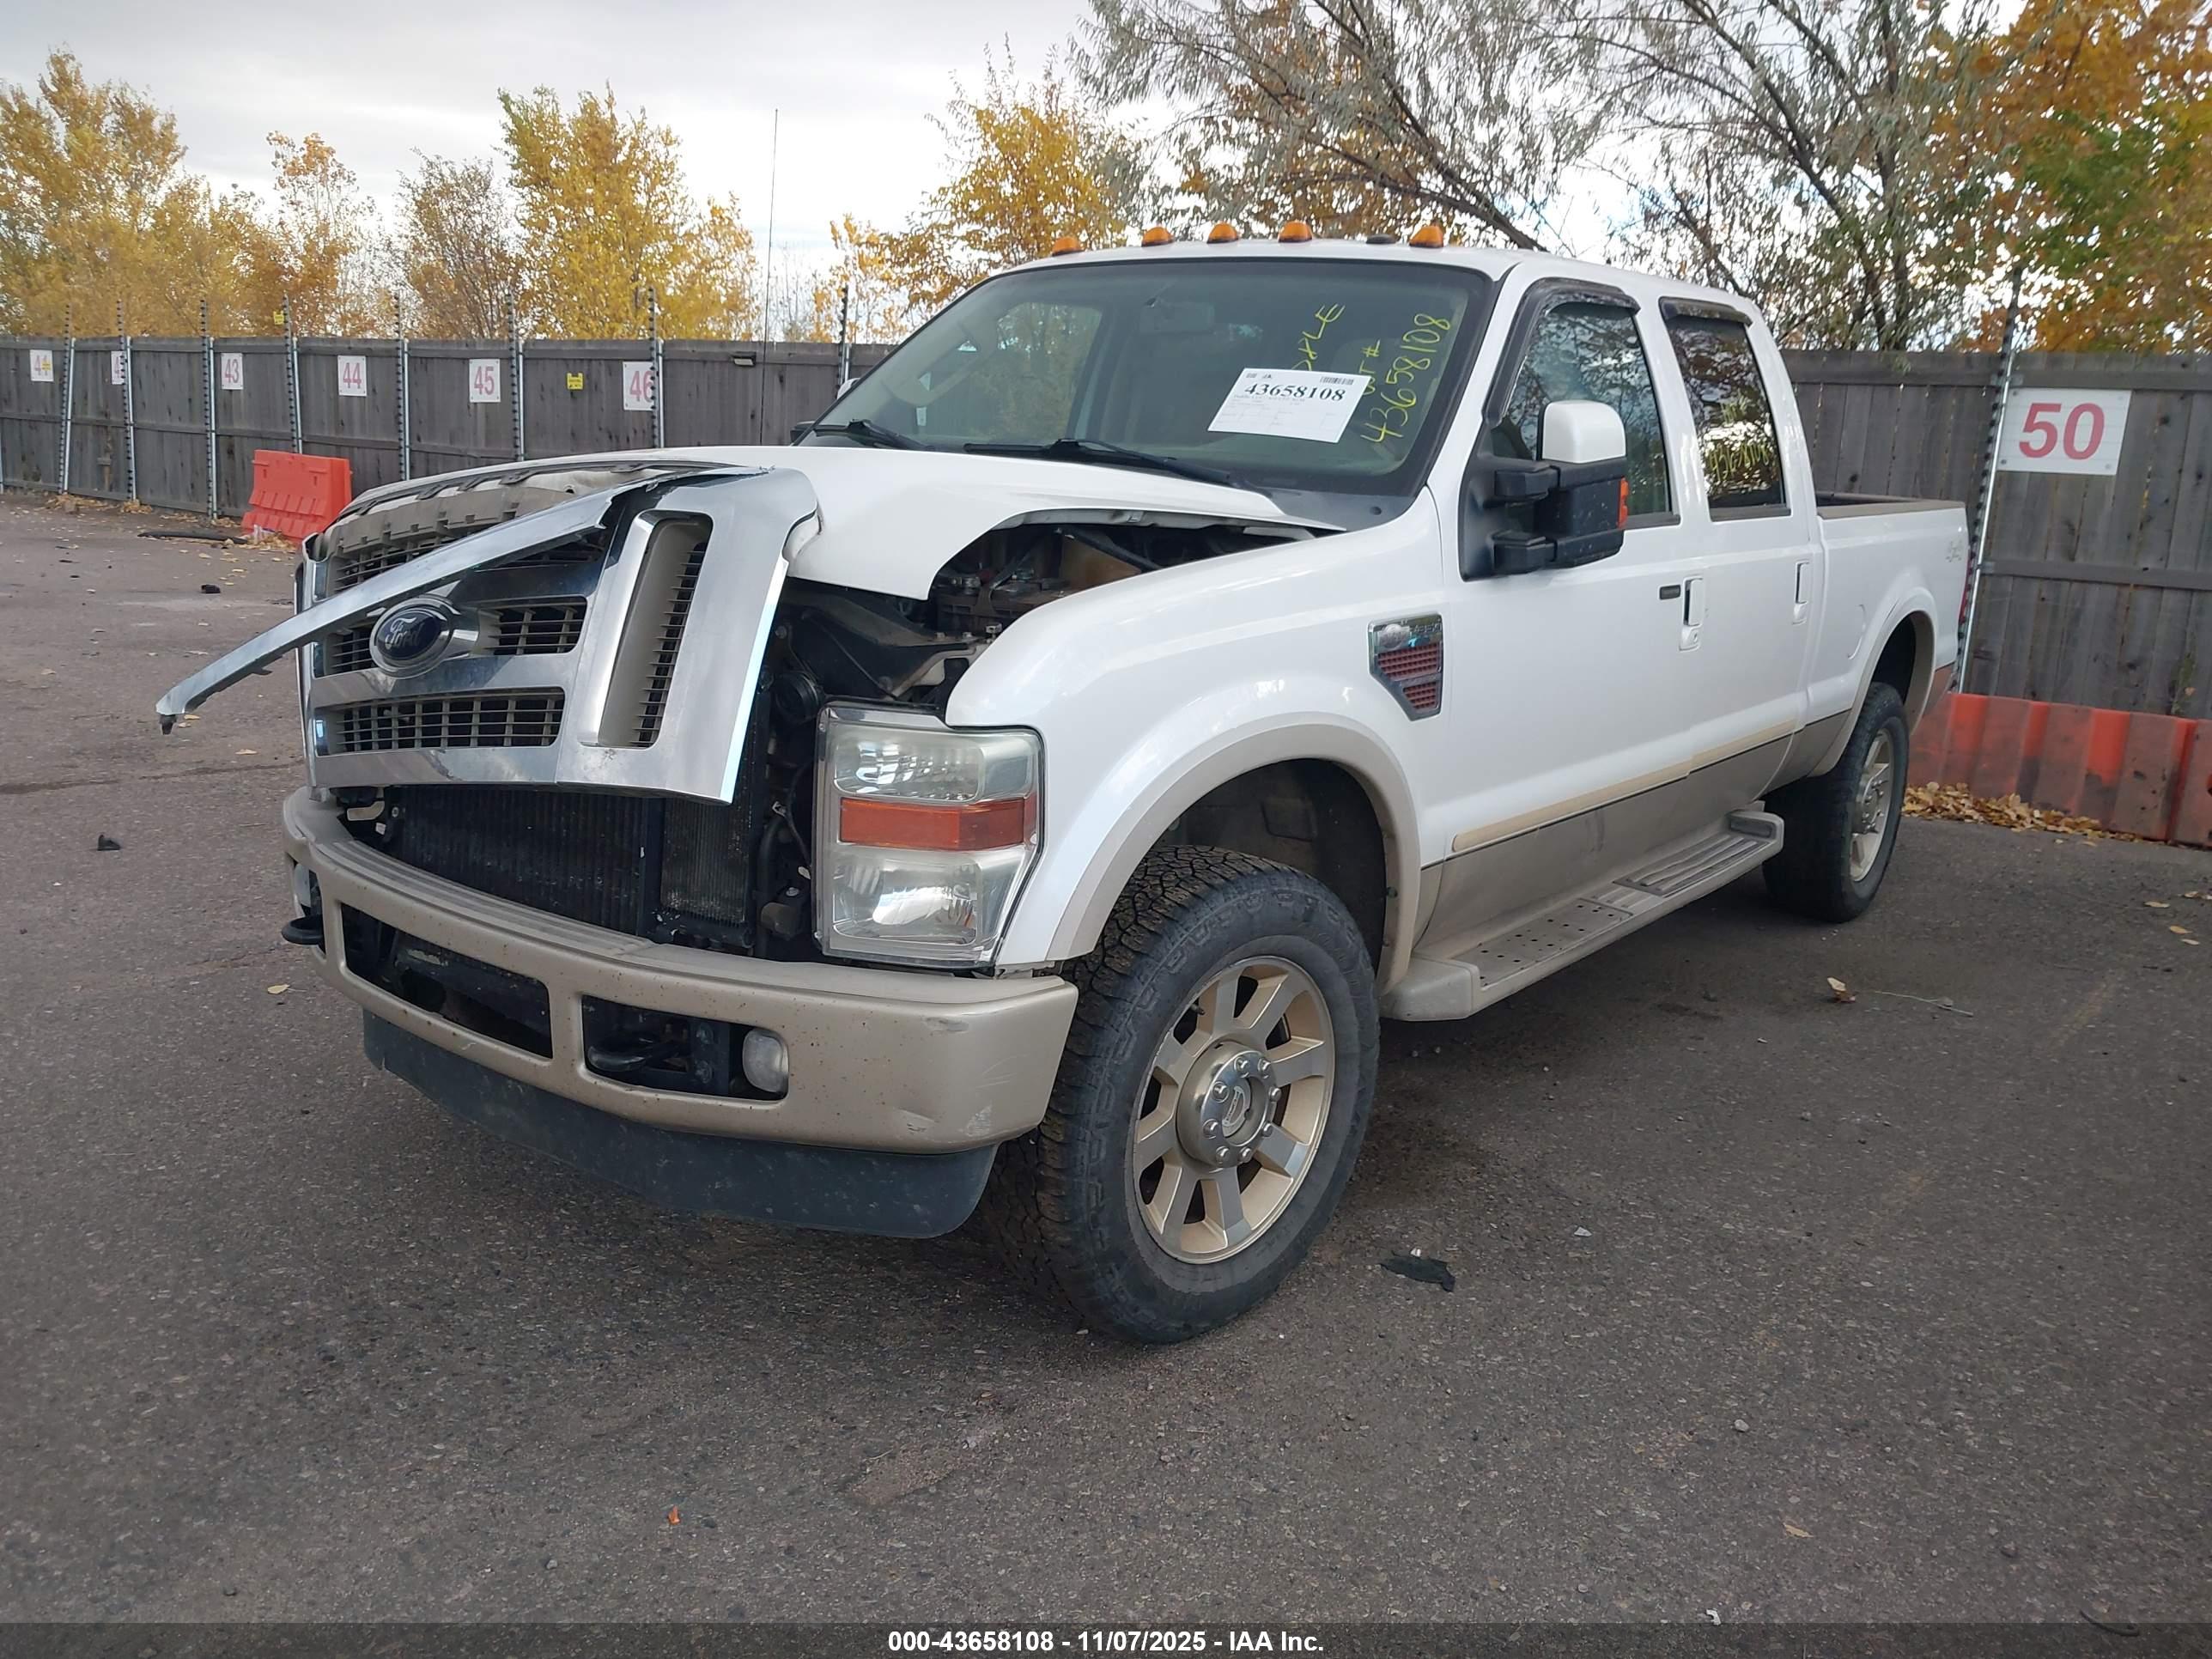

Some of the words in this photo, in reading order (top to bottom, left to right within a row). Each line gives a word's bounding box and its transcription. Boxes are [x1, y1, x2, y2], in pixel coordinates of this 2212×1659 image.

[224, 358, 240, 384] 43
[343, 362, 362, 389] 44
[473, 366, 495, 396] 45
[1360, 313, 1451, 443] 43658108
[629, 370, 653, 403] 46
[1244, 383, 1346, 402] 43658108
[2019, 402, 2105, 460] 50
